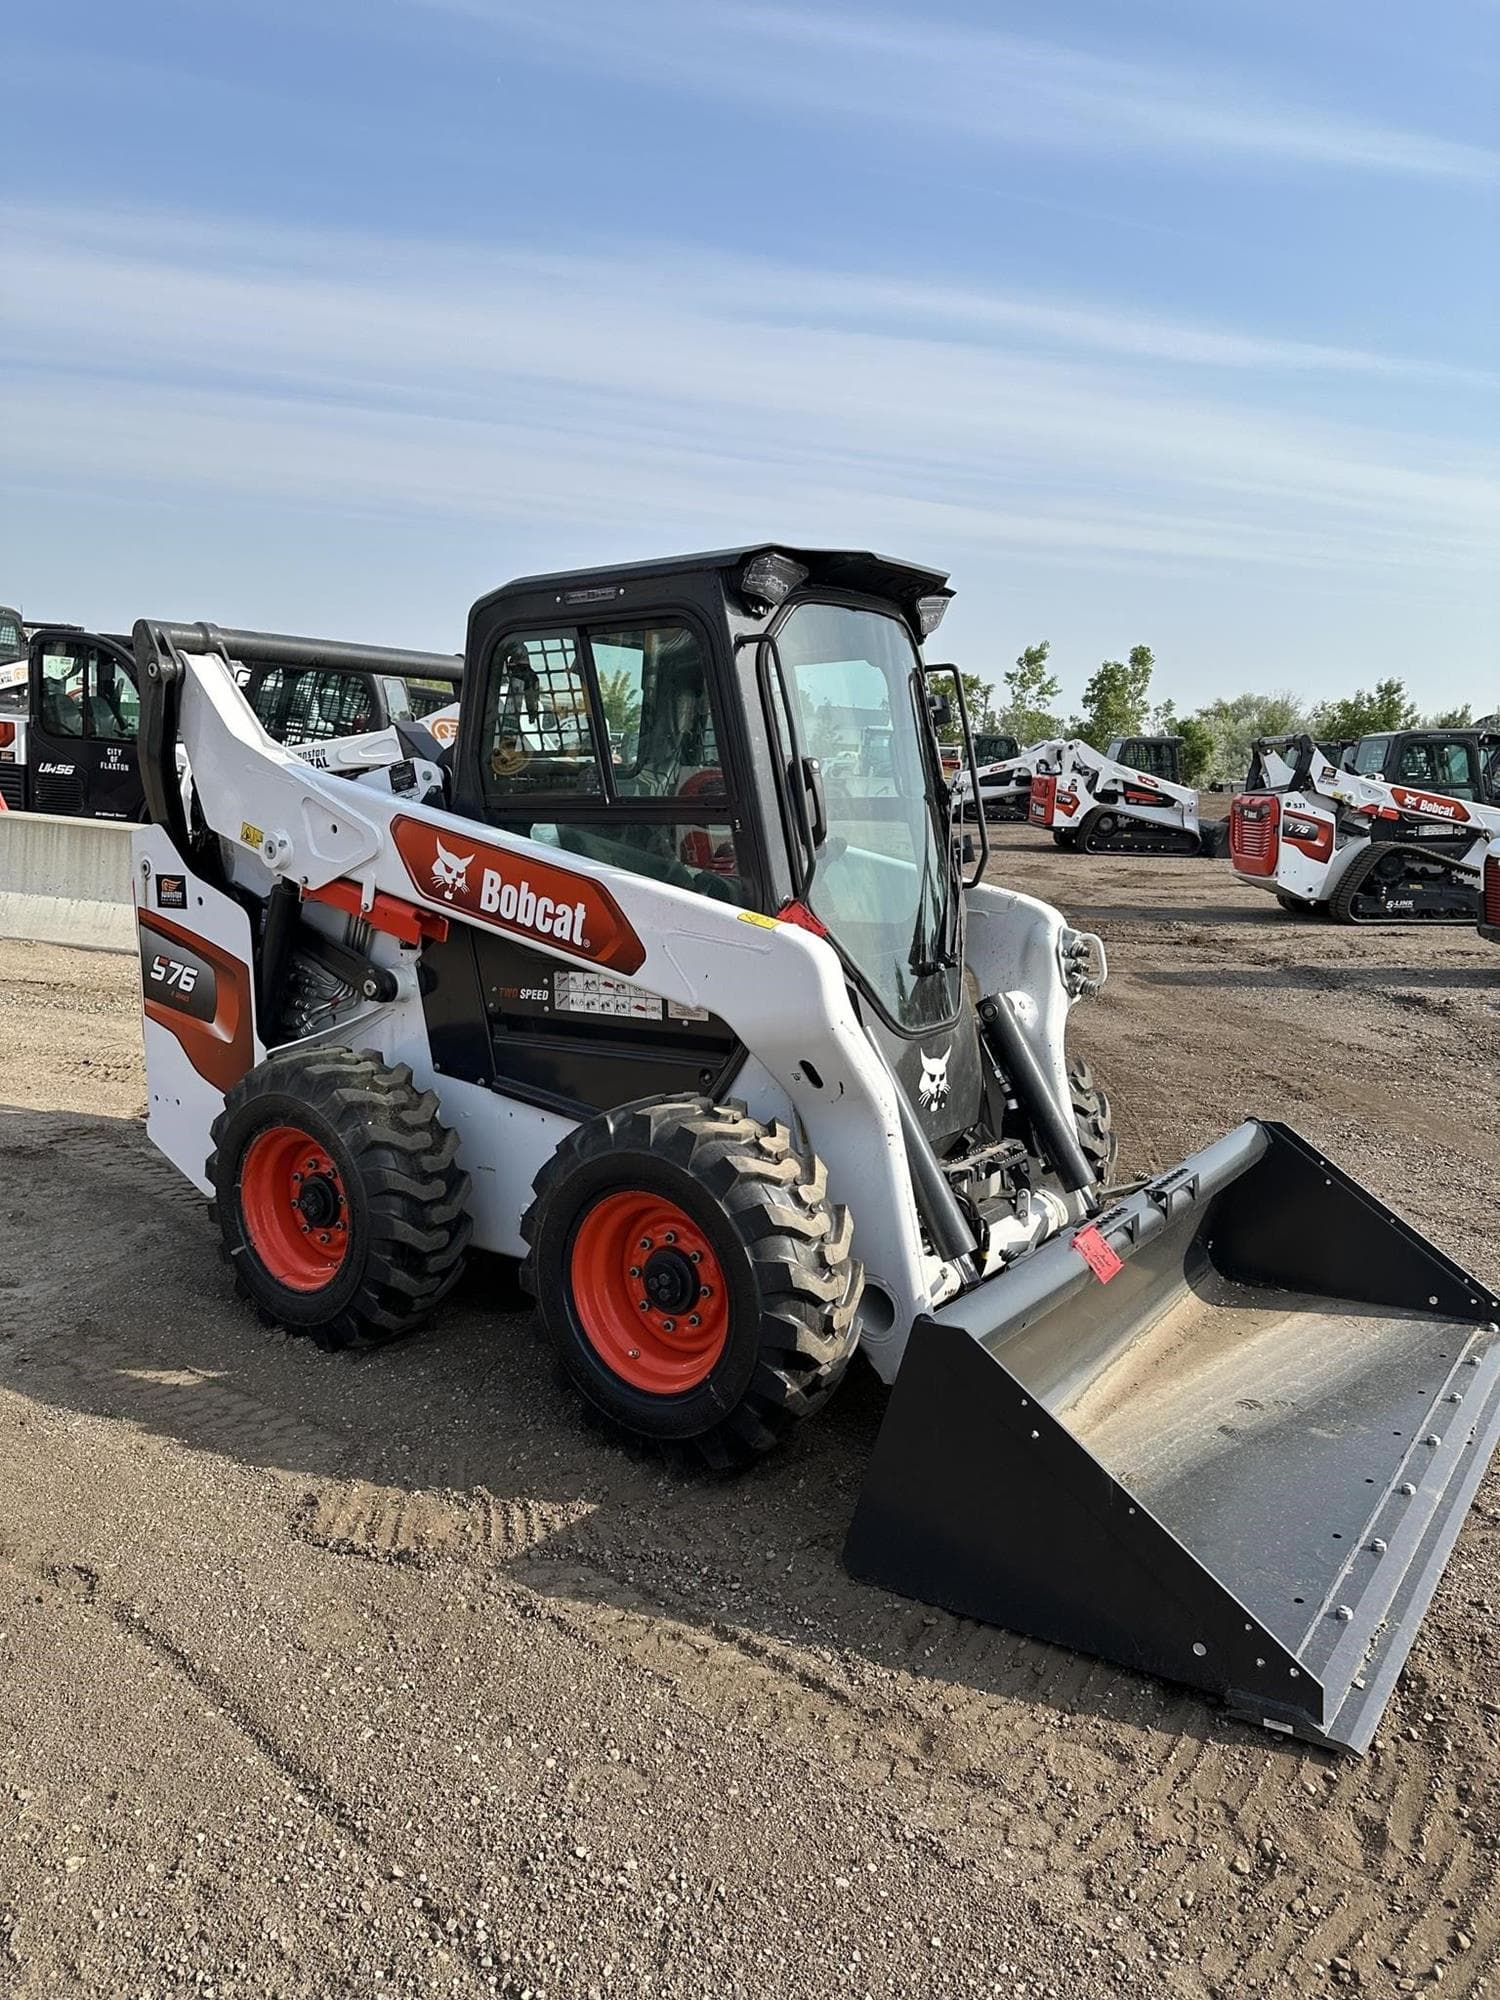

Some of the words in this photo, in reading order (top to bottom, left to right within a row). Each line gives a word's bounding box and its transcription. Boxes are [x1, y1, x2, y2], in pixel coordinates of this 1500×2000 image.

[106, 748, 122, 756] CITY
[100, 761, 129, 771] FLAXTON
[304, 756, 330, 769] TAL
[1420, 799, 1454, 817] Bobcat
[150, 955, 199, 992] S76
[520, 988, 549, 1000] SPEED
